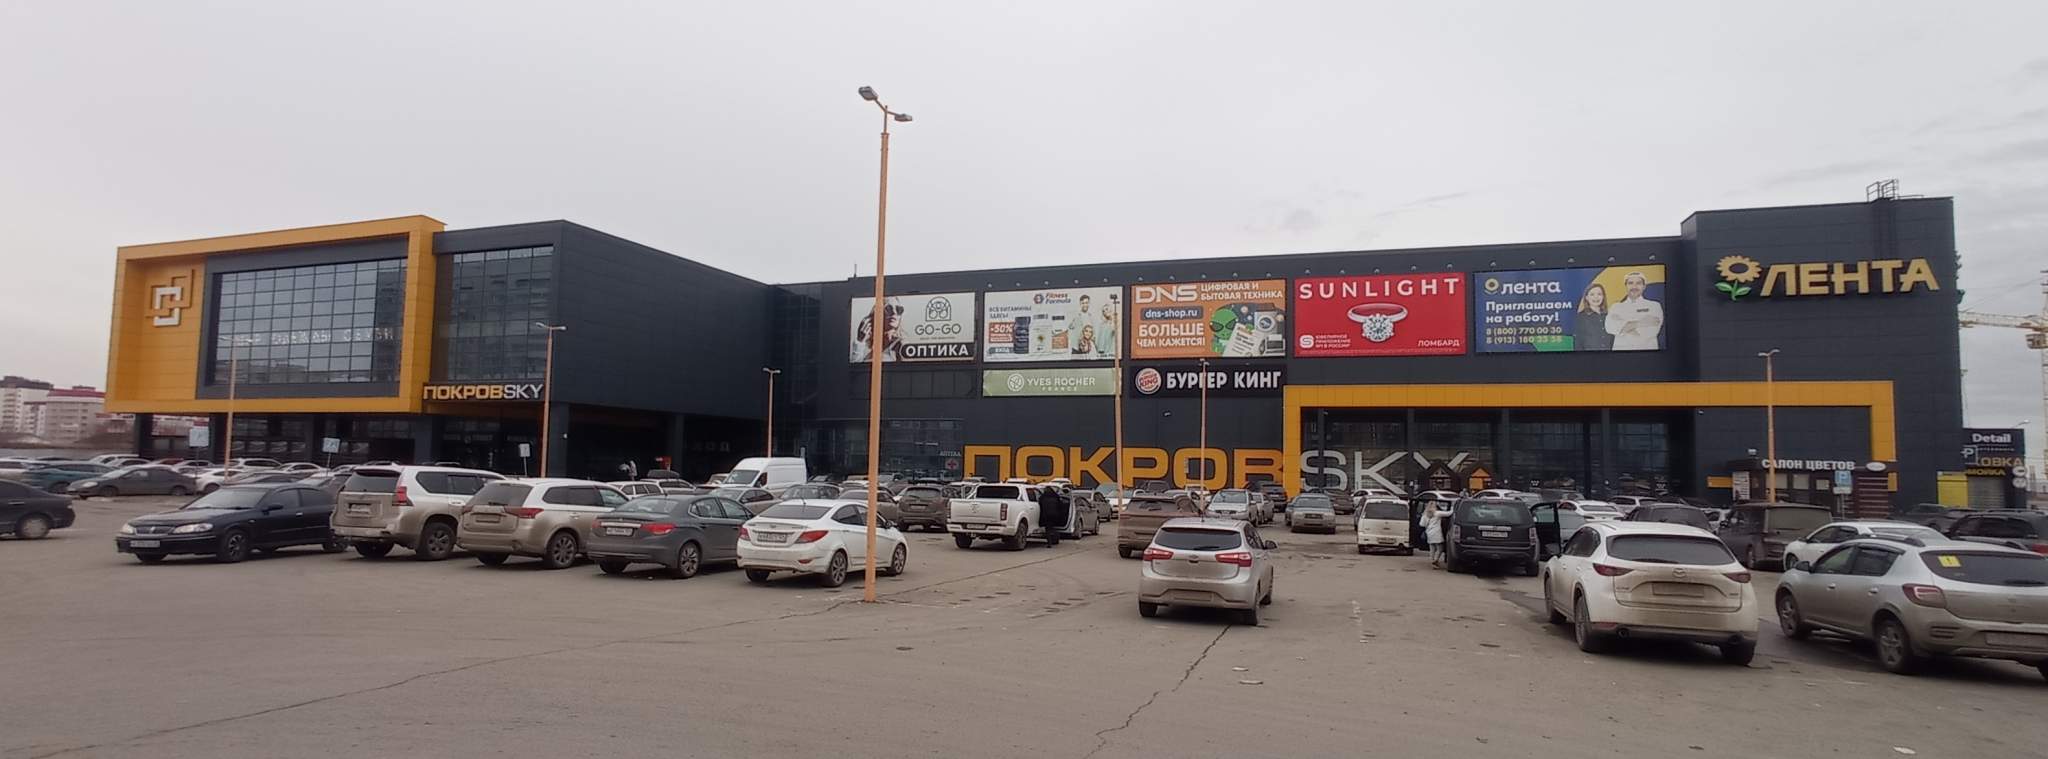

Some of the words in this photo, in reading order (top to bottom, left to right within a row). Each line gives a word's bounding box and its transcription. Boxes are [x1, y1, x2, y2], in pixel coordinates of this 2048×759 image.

[1760, 258, 1940, 297] ЛЕНТА
[1201, 282, 1250, 292] ЦИФРОВАЯ
[1252, 282, 1259, 290] И
[1299, 278, 1459, 300] SUNLIGHT
[1501, 281, 1561, 295] лента
[1135, 284, 1198, 304] DNS
[1201, 291, 1241, 301] БЫТОВАЯ
[1243, 290, 1284, 300] ТЕХНИКА
[1486, 301, 1572, 313] Приглашаем
[1145, 309, 1198, 319] dns-shop.ru
[1486, 316, 1502, 324] на
[1505, 314, 1559, 325] работу!
[914, 323, 962, 335] GO-GO
[1139, 323, 1204, 337] БОЛЬШЕ
[1137, 338, 1156, 348] ЧЕМ
[1159, 337, 1206, 346] КАЖЕТСЯ!
[1418, 339, 1460, 347] ЛОМБАРД
[905, 344, 969, 357] ОПТИКА
[1027, 377, 1052, 386] YVES
[1054, 377, 1096, 386] ROCHER
[1166, 372, 1228, 389] БУРГЕР
[1234, 371, 1281, 388] КИНГ
[1972, 433, 2012, 443] Detail
[1805, 460, 1856, 471] ЦВЕТОВ
